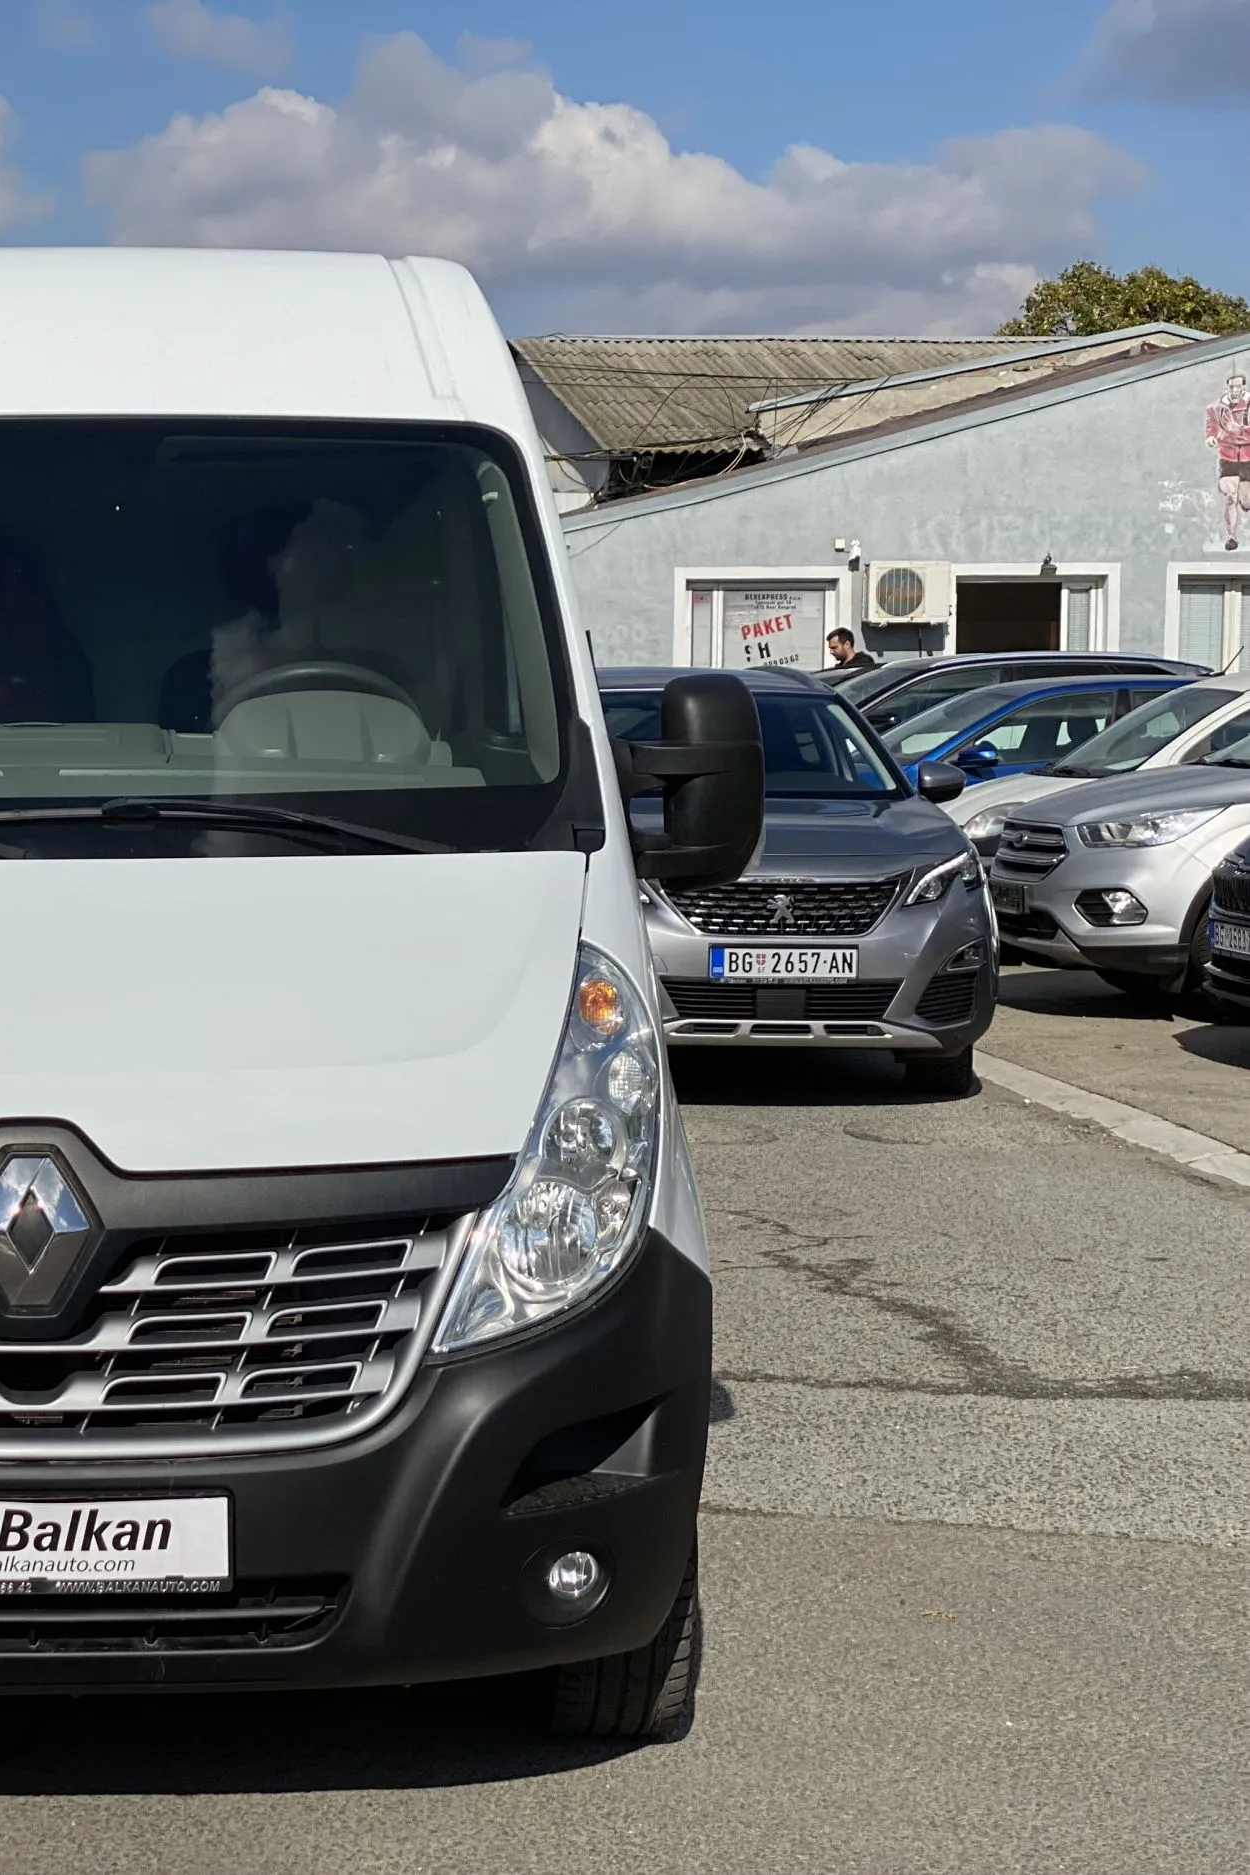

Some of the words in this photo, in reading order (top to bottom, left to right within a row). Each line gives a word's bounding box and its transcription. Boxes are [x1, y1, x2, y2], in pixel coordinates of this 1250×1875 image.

[740, 614, 793, 641] PAKET
[728, 951, 753, 974] BG
[16, 1581, 33, 1594] 42
[55, 1580, 222, 1595] WWW.BALKANAUTO.COM
